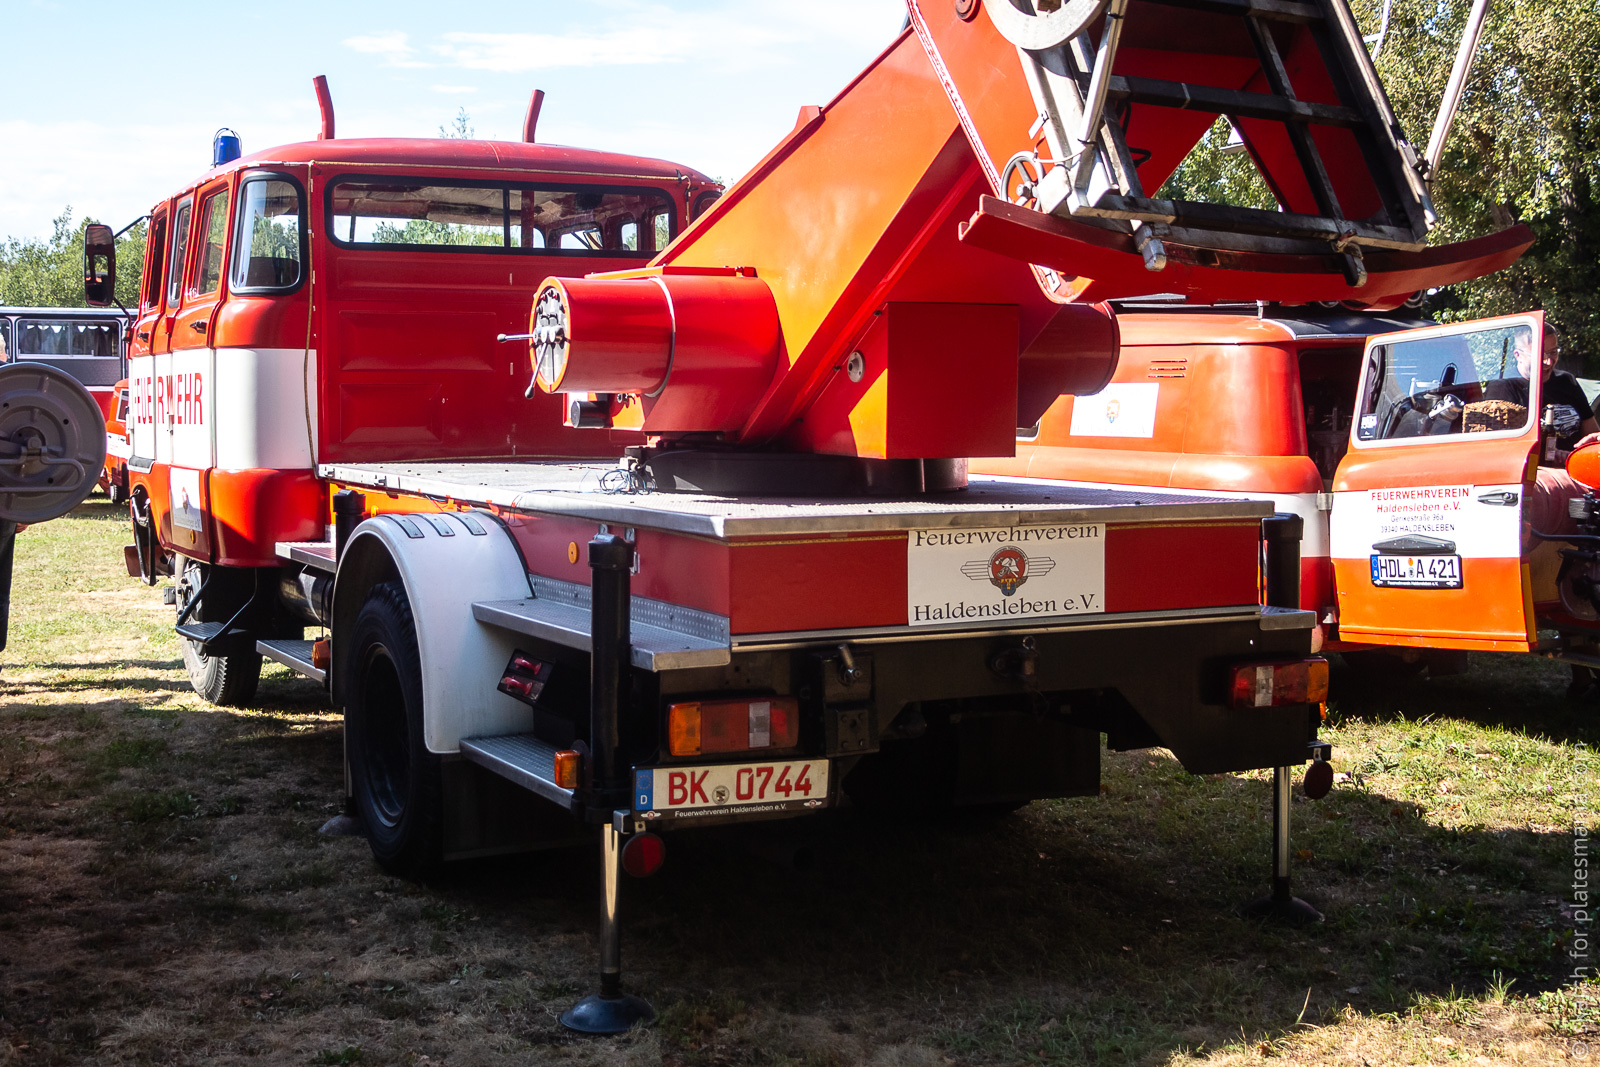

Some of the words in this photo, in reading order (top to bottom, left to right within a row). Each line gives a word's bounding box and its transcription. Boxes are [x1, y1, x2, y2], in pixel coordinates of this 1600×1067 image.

[134, 372, 203, 425] FEUERWEHR
[1371, 488, 1470, 501] FEUERWEHRVEREIN
[1376, 503, 1440, 513] Haldensleben
[1443, 501, 1461, 511] e.V.
[915, 524, 1099, 547] Feuerwehrverein
[1399, 523, 1455, 533] HALDENSLEBEN
[1379, 558, 1406, 578] HDL
[1416, 559, 1425, 579] A
[1428, 558, 1457, 579] 421
[914, 598, 1058, 621] Haldensleben
[1063, 593, 1100, 611] e.V.
[668, 770, 709, 805] BK
[735, 764, 812, 800] 0744
[639, 795, 648, 805] D
[674, 808, 730, 817] Feuerwehrverein
[730, 804, 774, 814] Haldensleben
